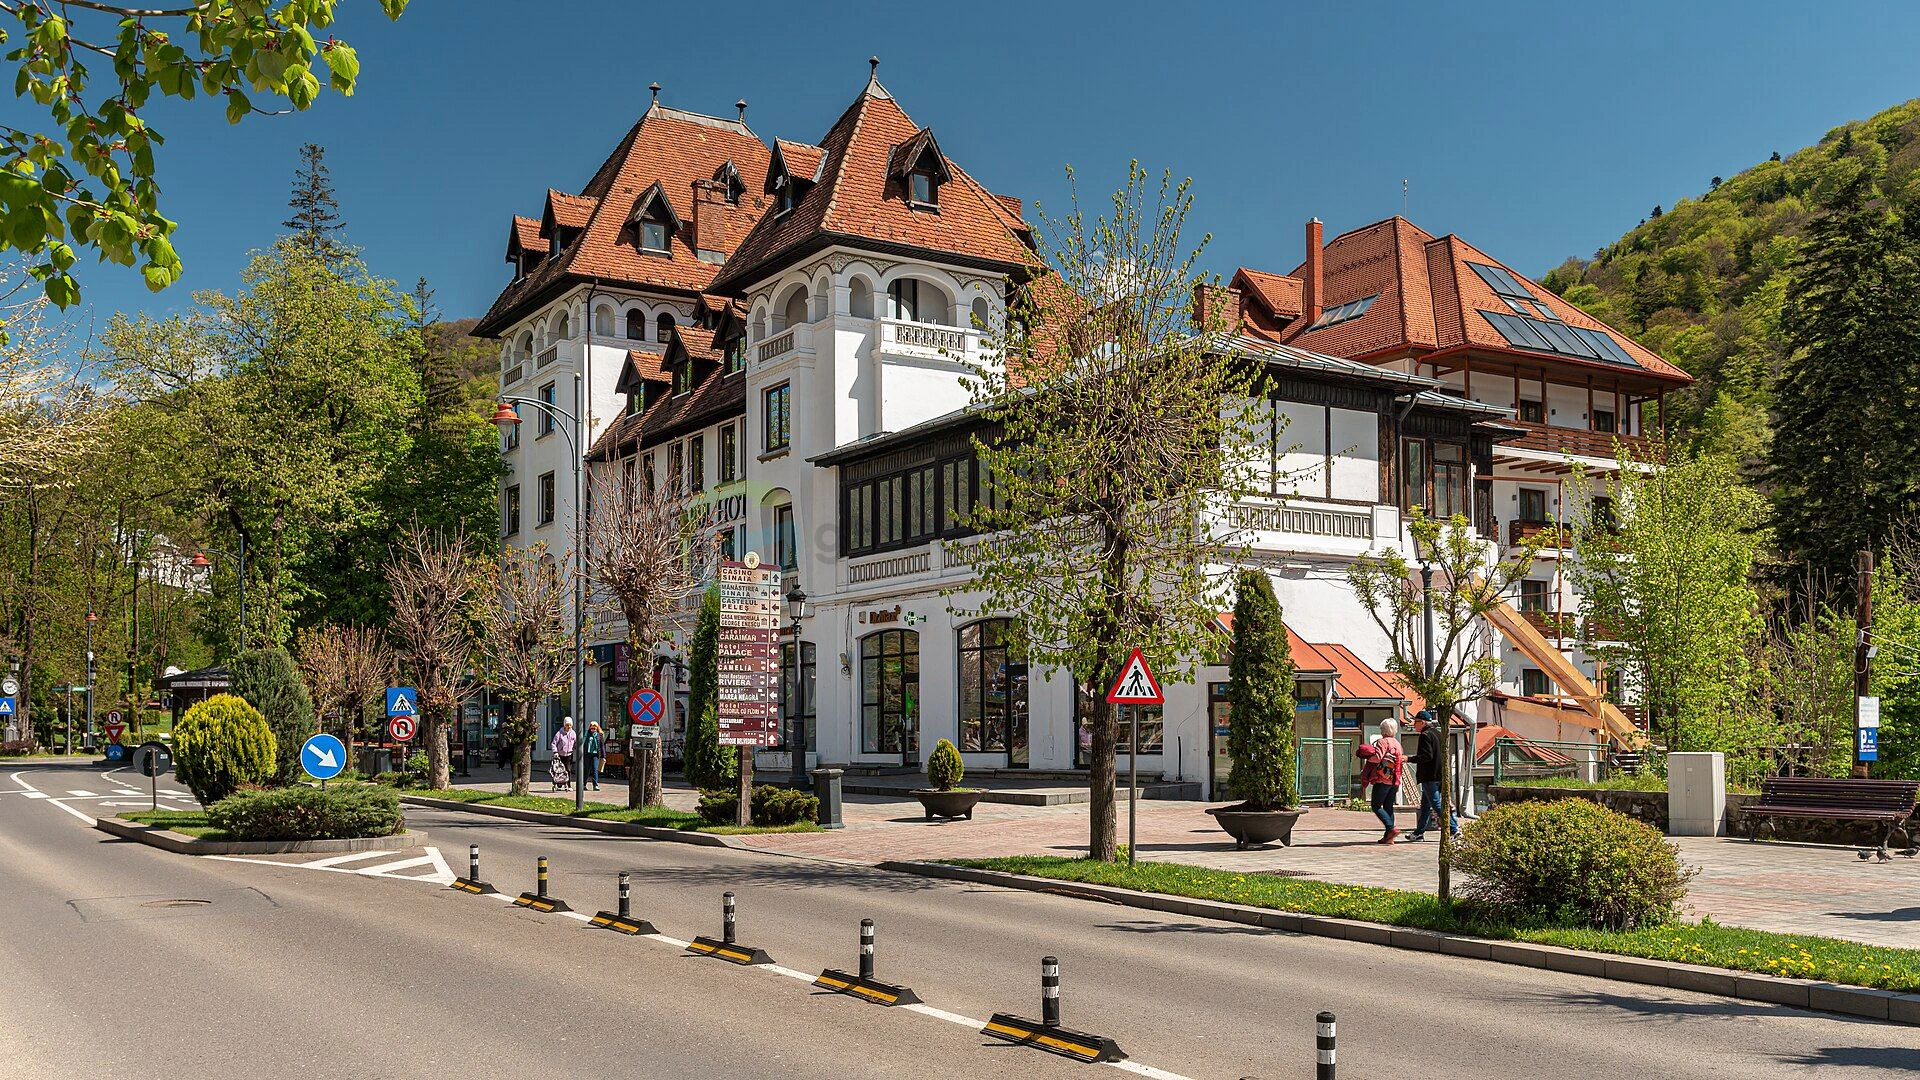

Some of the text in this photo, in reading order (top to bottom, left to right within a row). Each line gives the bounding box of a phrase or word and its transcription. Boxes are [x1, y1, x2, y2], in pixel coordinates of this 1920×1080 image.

[721, 598, 758, 606] CASTELUL
[741, 620, 760, 628] ENESCU
[719, 633, 757, 641] CARAIMAN
